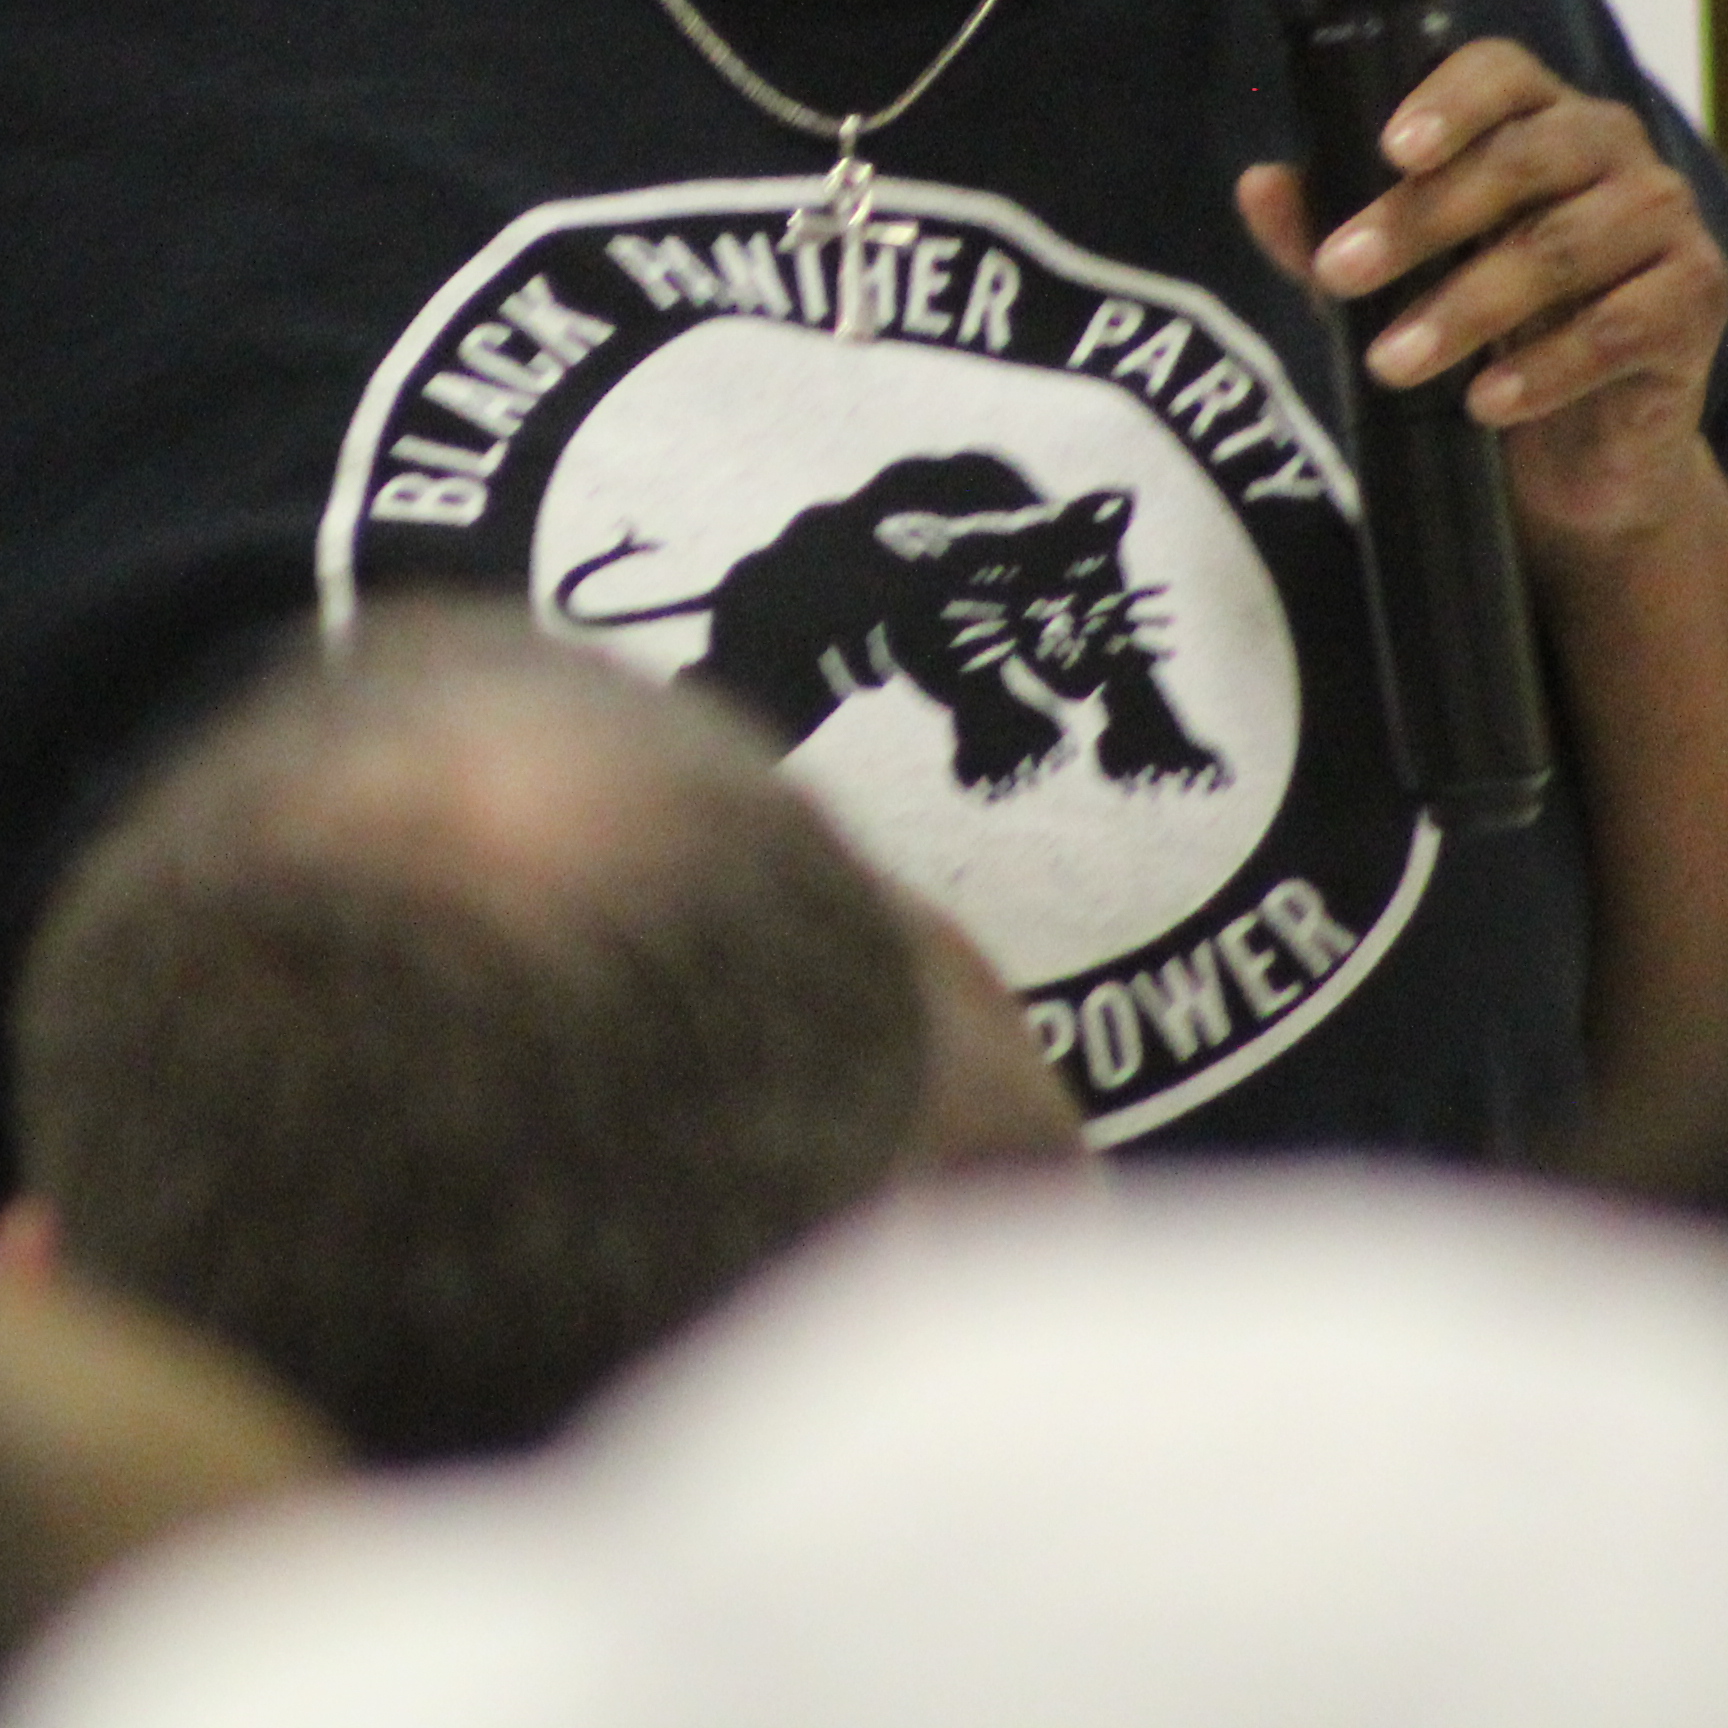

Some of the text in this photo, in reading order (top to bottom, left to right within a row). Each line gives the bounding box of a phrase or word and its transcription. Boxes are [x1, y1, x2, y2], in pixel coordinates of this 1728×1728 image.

[370, 230, 1329, 527] BLACK PANTHER PARTY
[1024, 877, 1360, 1092] POWER
